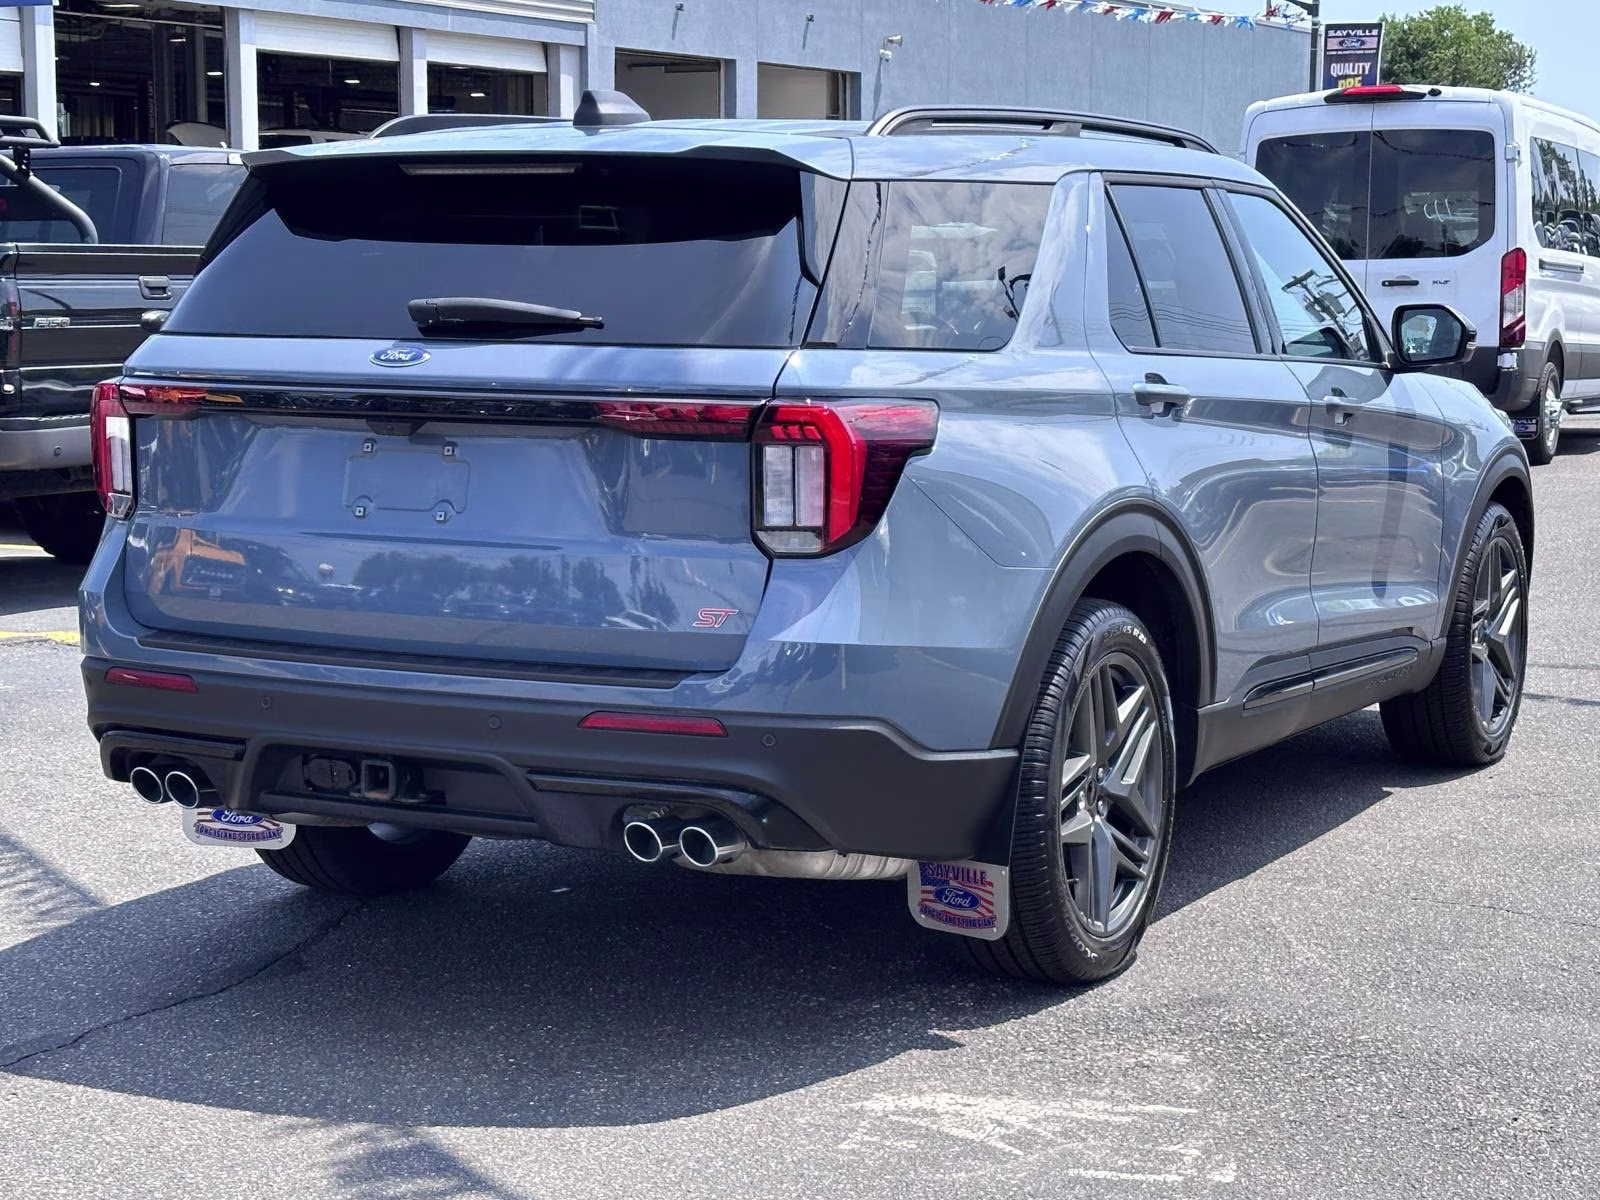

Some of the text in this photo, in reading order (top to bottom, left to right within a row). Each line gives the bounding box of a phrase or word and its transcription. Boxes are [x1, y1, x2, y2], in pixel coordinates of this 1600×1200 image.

[1327, 29, 1379, 37] SAYVILLE
[1330, 62, 1372, 77] QUALITY
[692, 607, 740, 628] ST
[261, 829, 281, 840] GIANT
[927, 863, 988, 886] SAYVILLE
[942, 888, 972, 908] Ford
